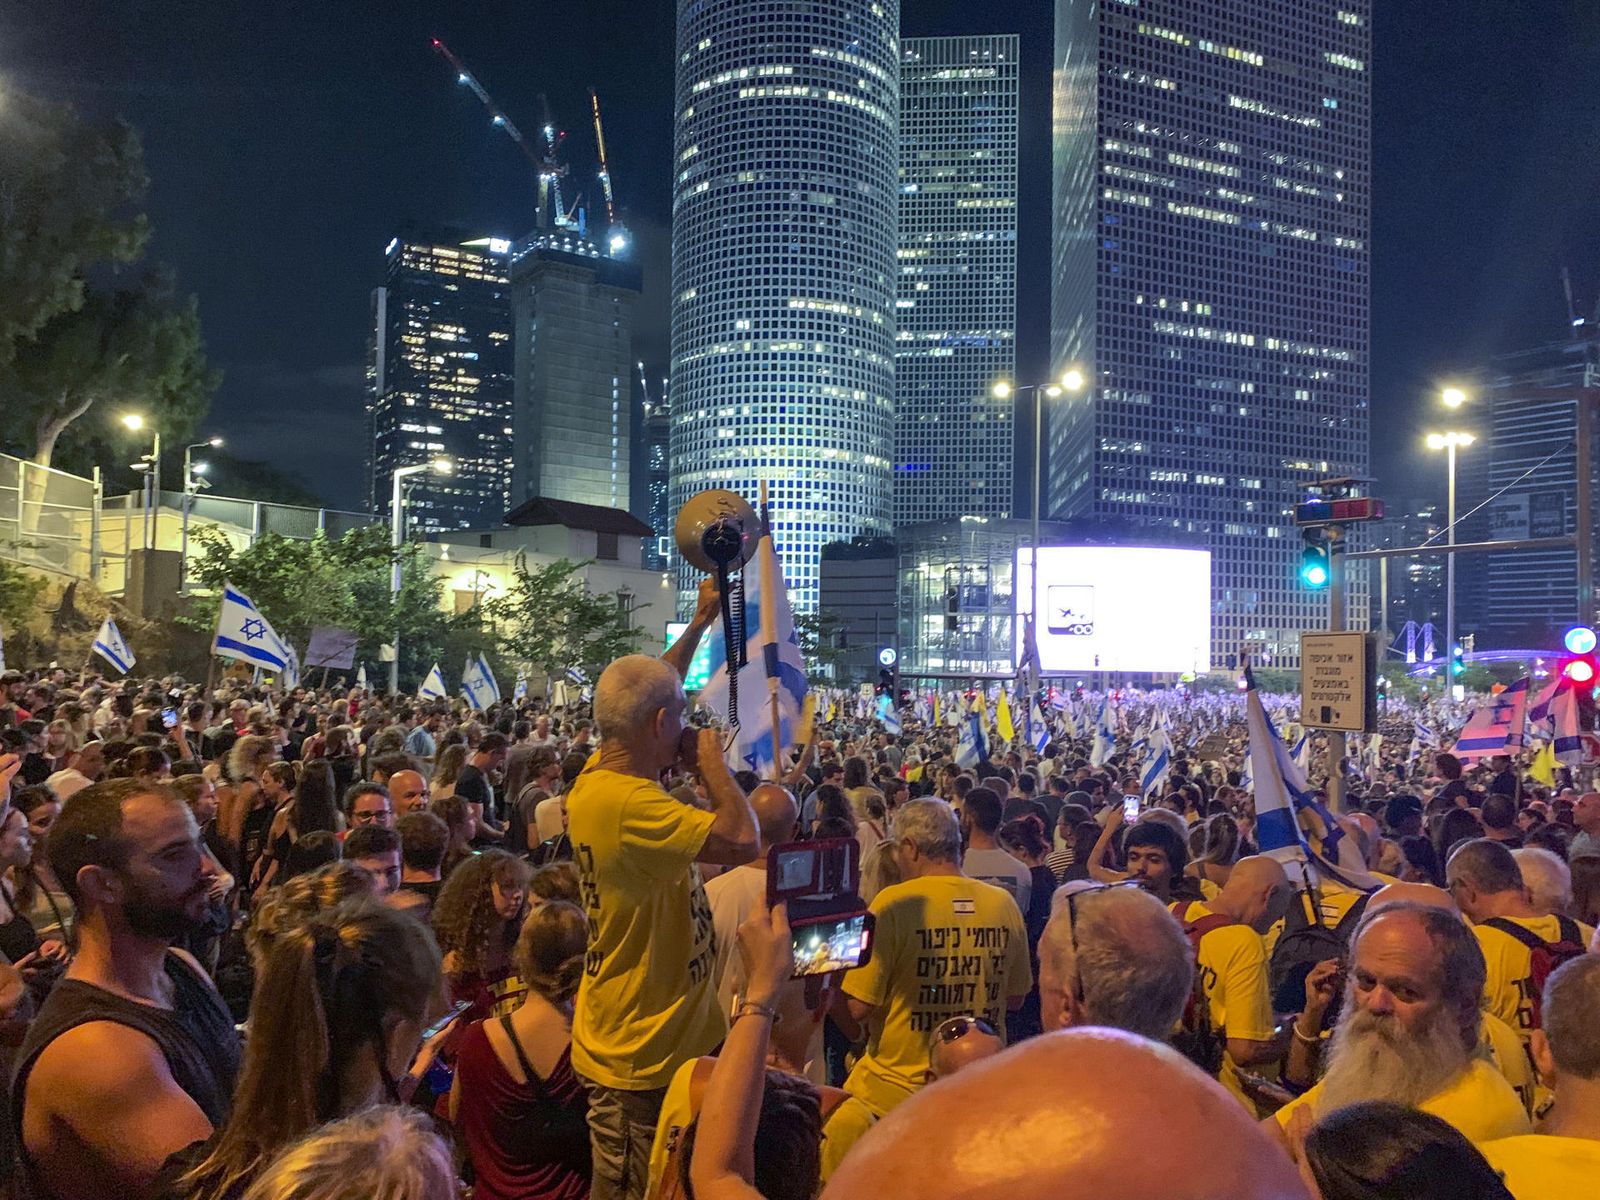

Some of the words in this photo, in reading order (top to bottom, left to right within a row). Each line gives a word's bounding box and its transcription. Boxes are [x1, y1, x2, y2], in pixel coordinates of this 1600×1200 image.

[916, 927, 960, 949] כיפור
[967, 926, 1010, 949] לוחמי
[917, 956, 981, 979] נאבקים
[919, 982, 977, 1005] דמותה
